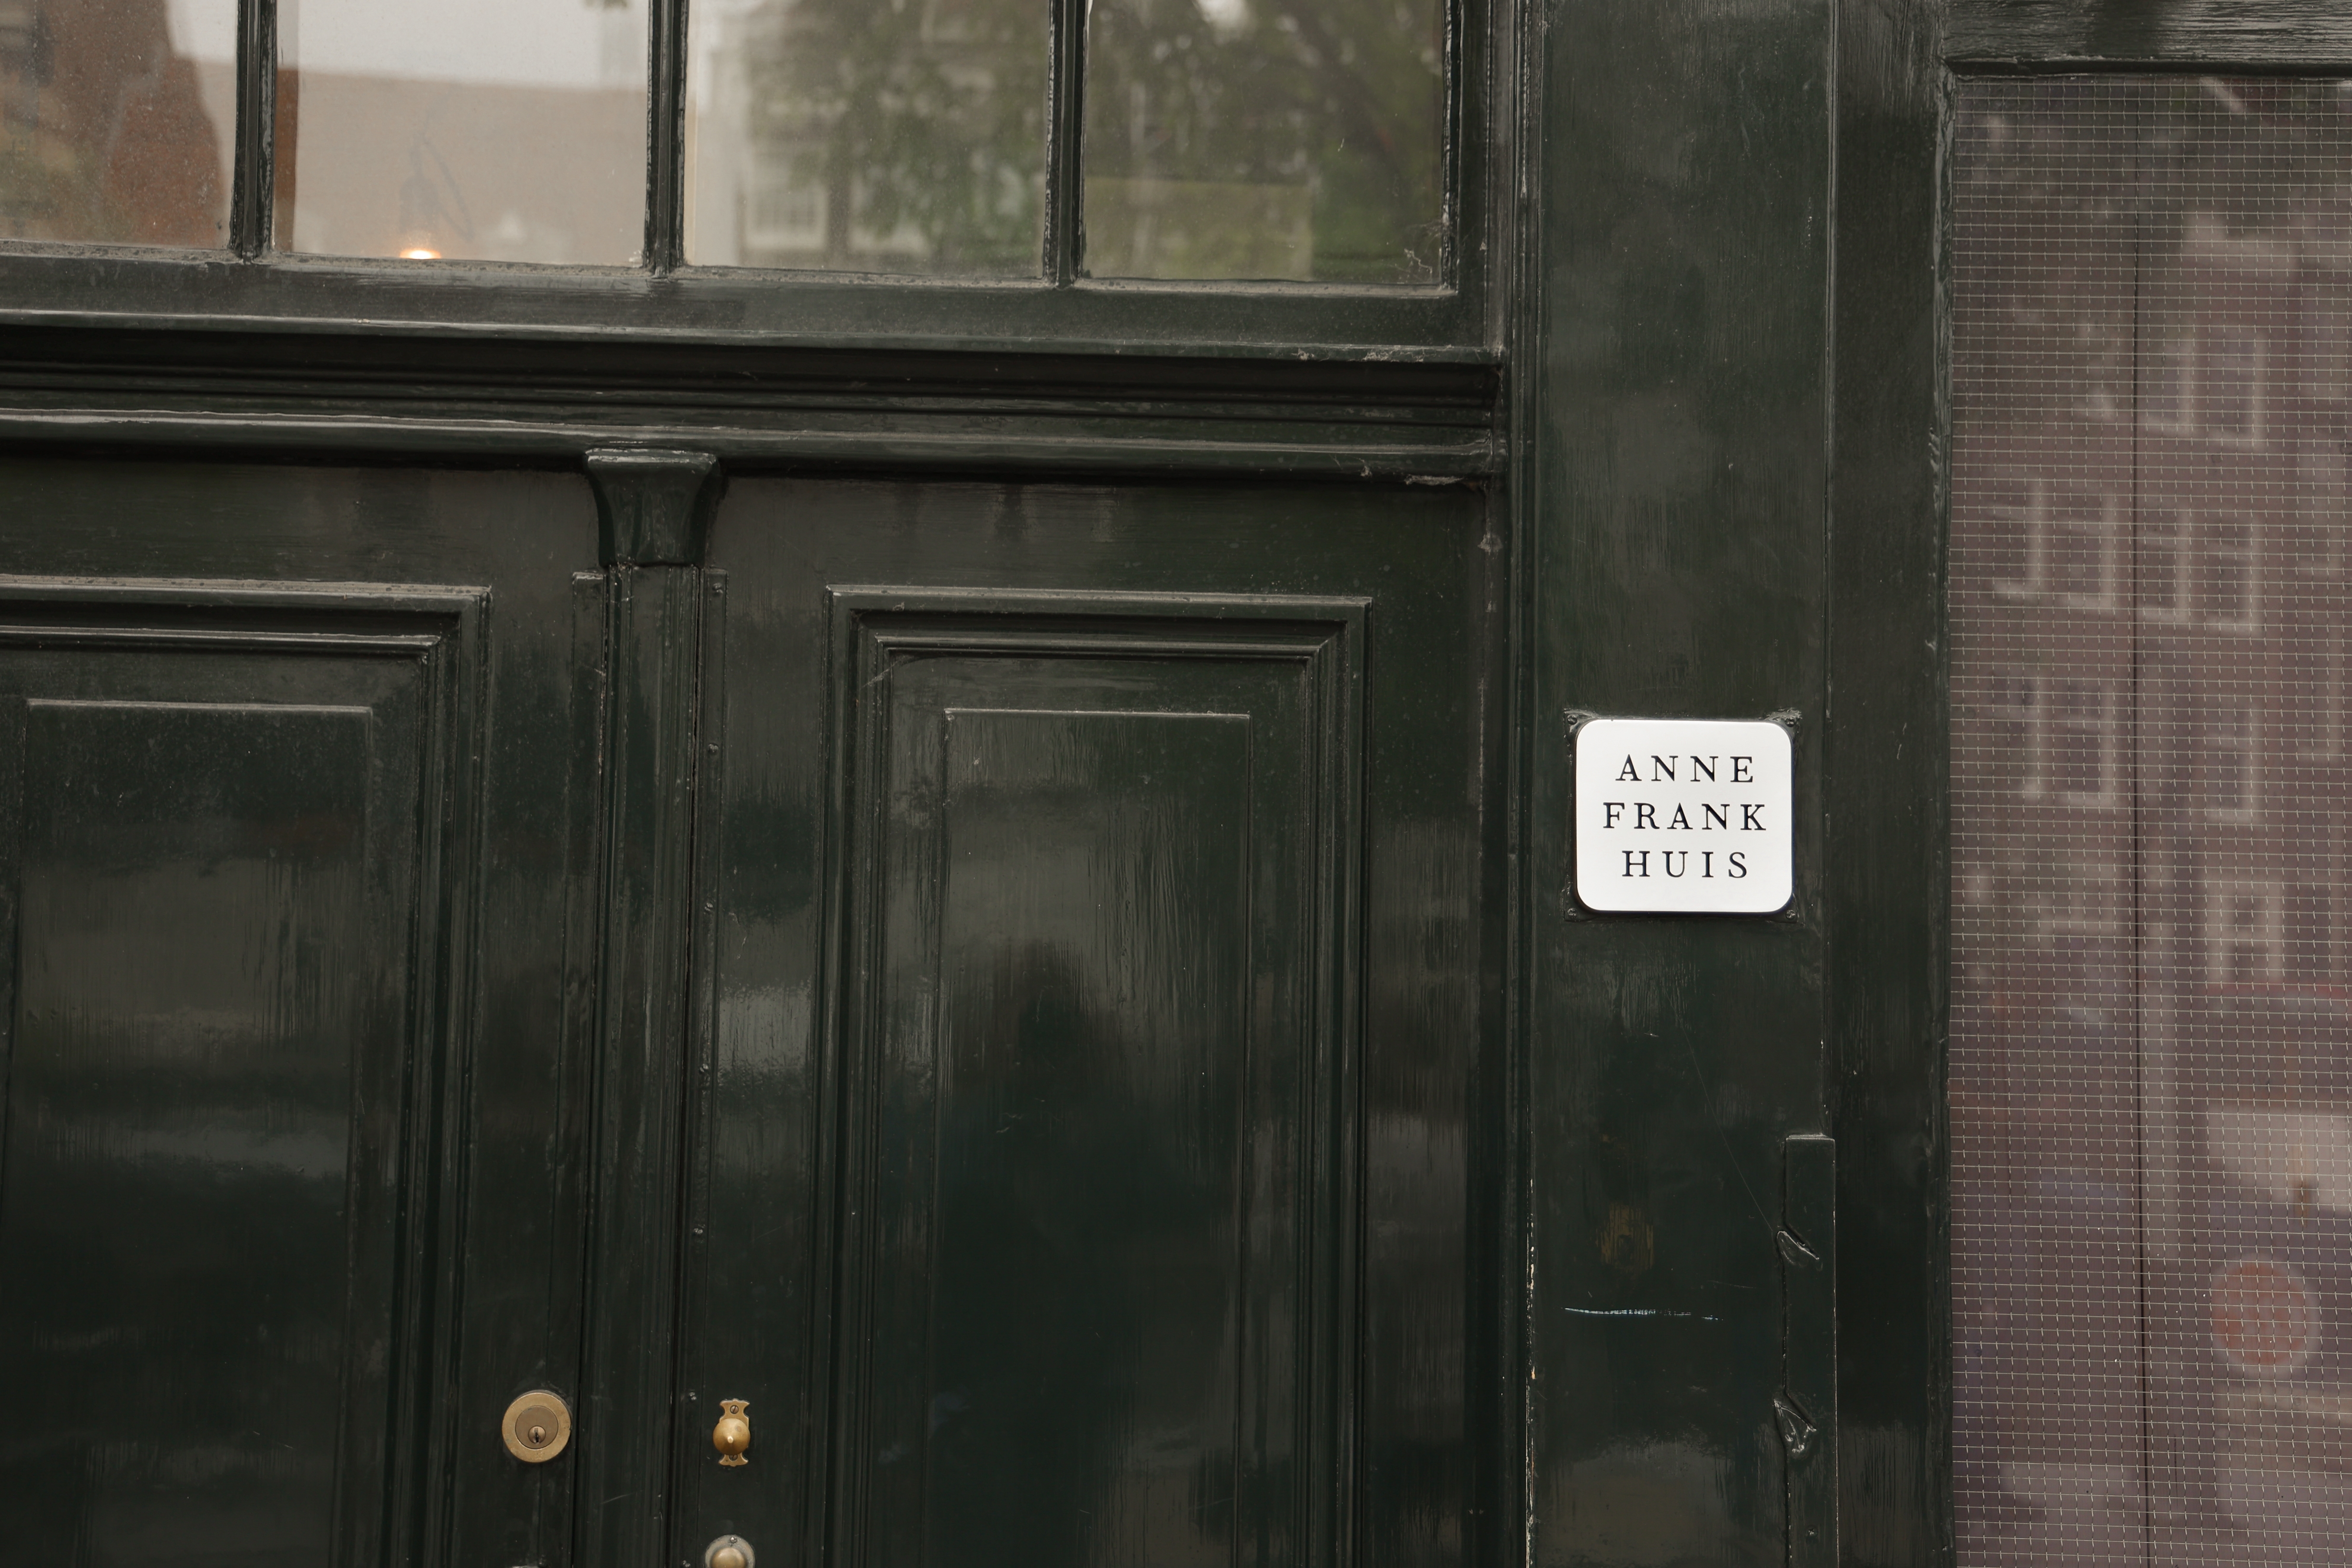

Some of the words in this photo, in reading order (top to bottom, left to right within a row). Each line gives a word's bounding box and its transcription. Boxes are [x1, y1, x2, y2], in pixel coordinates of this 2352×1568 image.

[1615, 754, 1753, 783] ANNE
[1603, 802, 1766, 831] FRANK
[1622, 851, 1747, 878] HUIS
